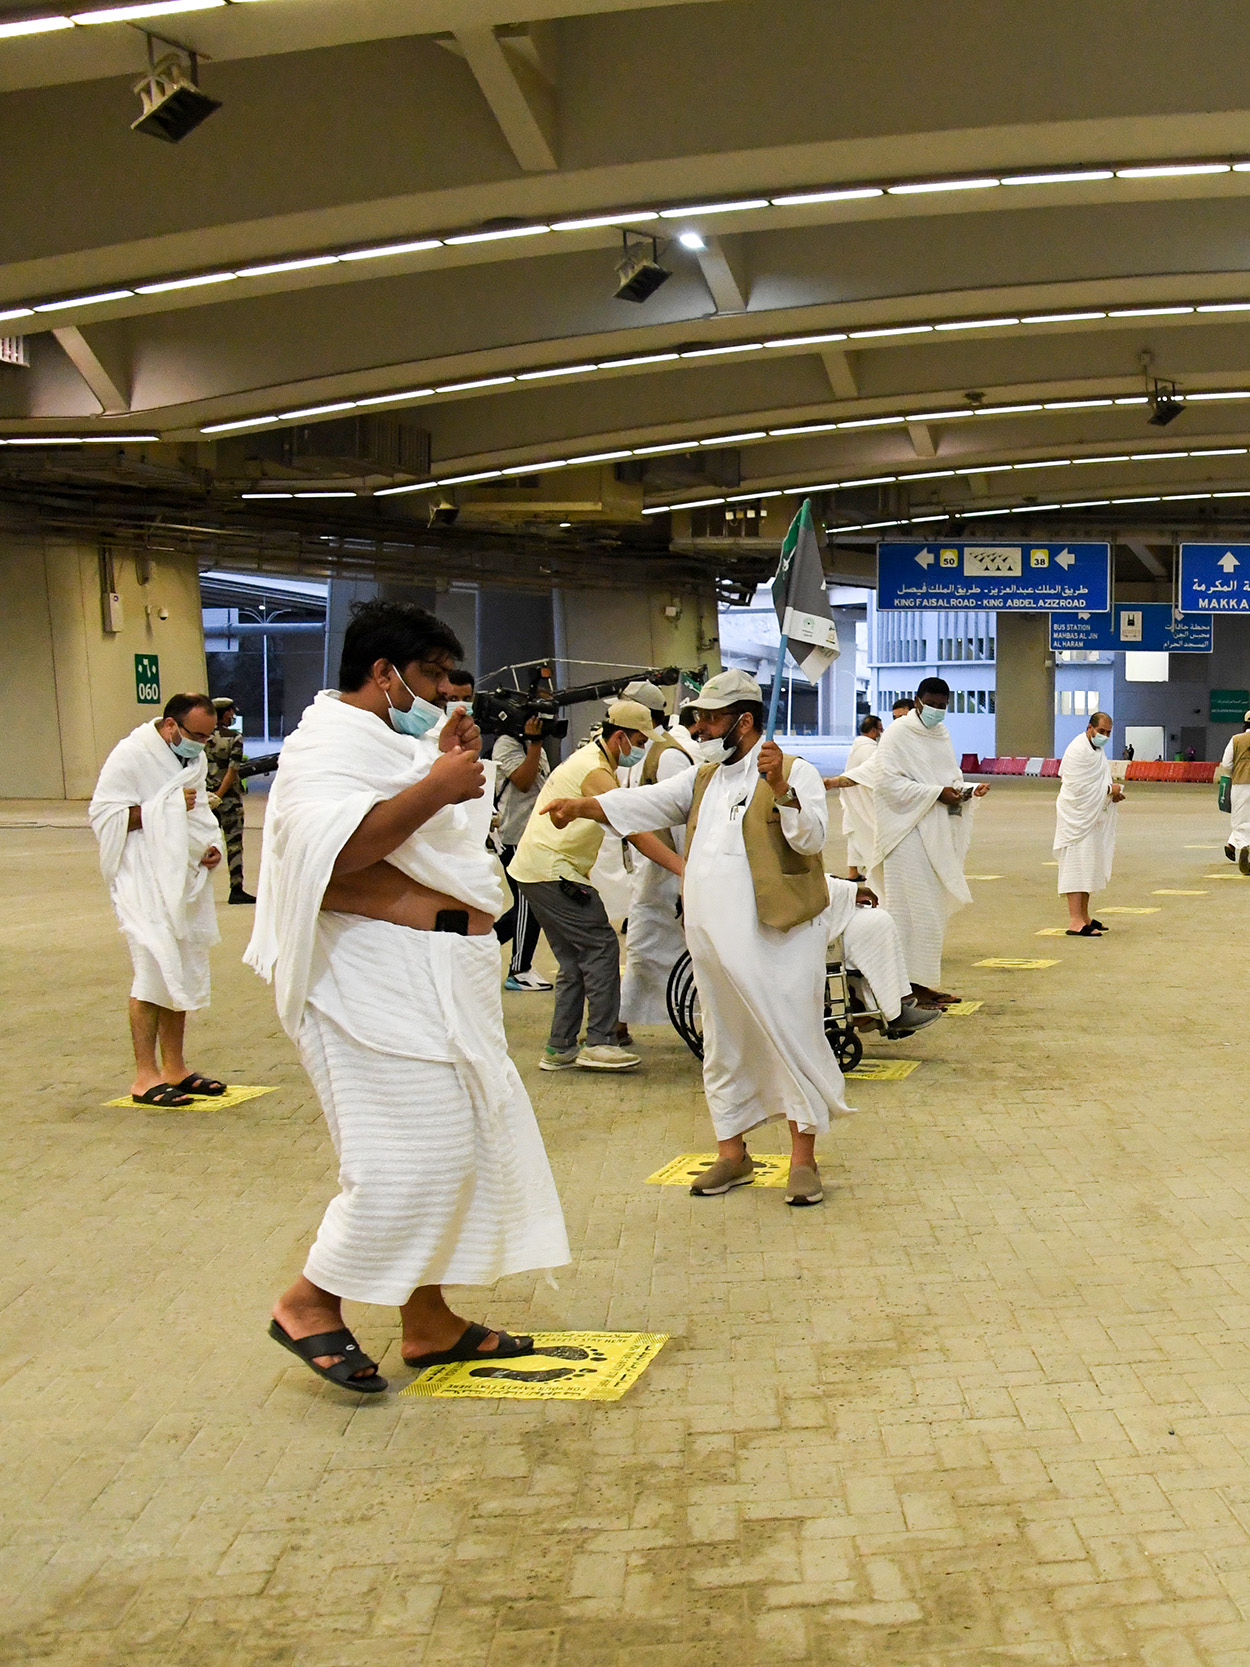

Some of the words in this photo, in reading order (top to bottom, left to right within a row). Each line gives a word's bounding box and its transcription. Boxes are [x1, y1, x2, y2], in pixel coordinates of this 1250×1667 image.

[943, 557, 955, 566] 50
[1033, 557, 1046, 566] 38
[897, 583, 927, 595] فيصل
[928, 584, 954, 593] الملك
[954, 584, 981, 596] طريق
[1035, 584, 1061, 594] الملك
[1061, 585, 1088, 597] طريق
[1192, 578, 1237, 595] المكرمة
[894, 599, 915, 607] KING
[916, 599, 950, 607] FAISAL
[950, 599, 976, 607] ROAD
[983, 599, 1004, 607] KING
[1006, 599, 1037, 607] ABDEL
[1037, 599, 1060, 607] AZIZ
[1060, 599, 1086, 607] ROAD
[138, 683, 159, 700] 060
